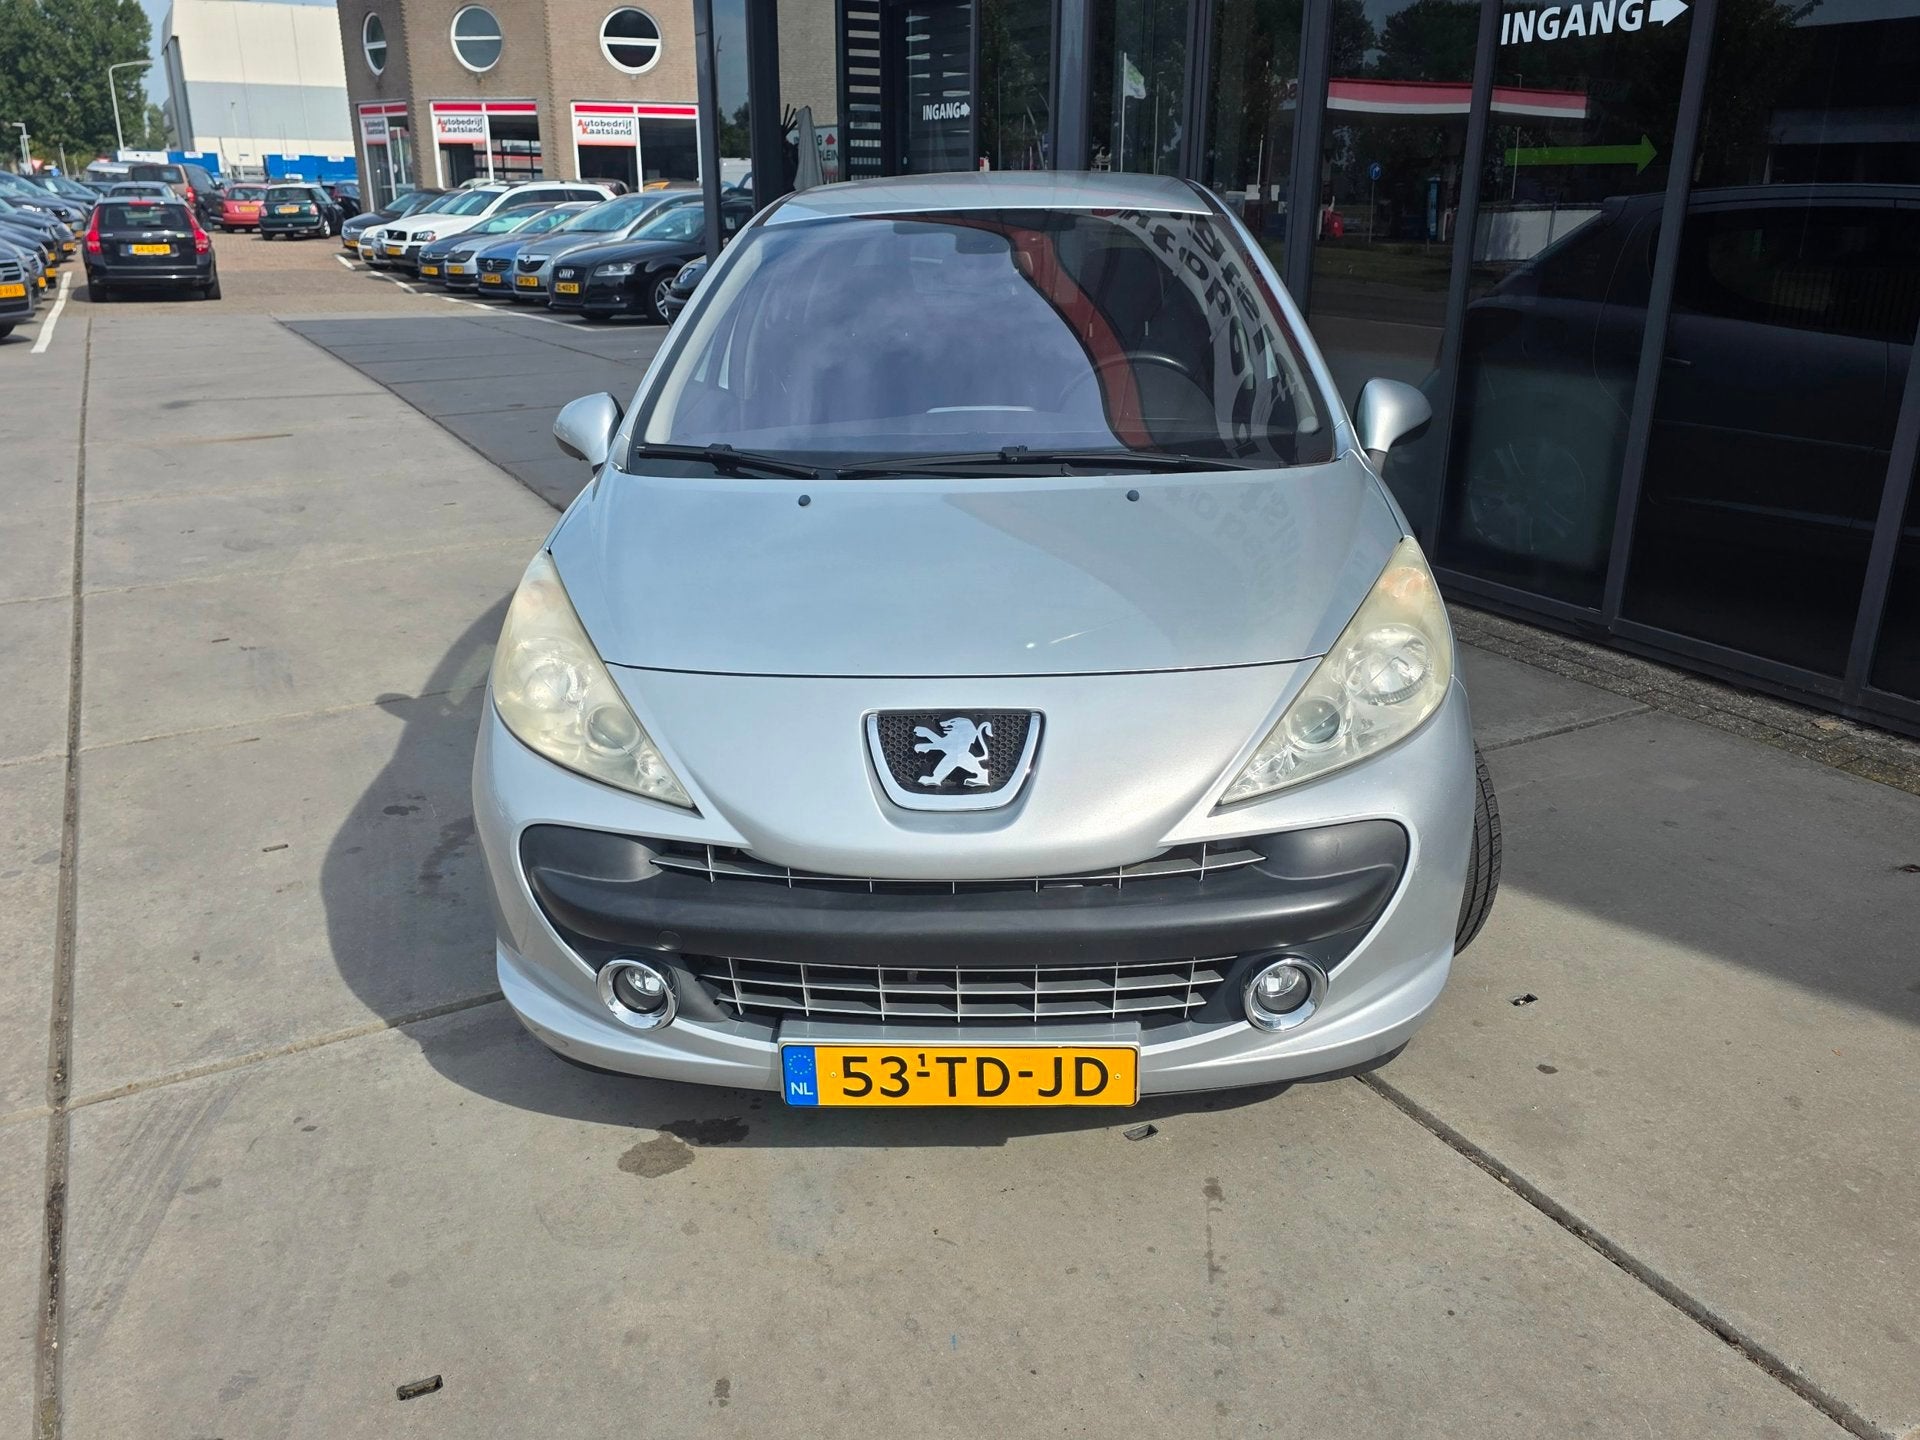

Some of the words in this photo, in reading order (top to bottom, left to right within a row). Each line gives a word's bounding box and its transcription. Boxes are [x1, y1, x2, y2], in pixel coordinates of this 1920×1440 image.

[1500, 0, 1644, 46] INGANG
[922, 101, 961, 121] INGANG
[437, 117, 483, 128] Autobedrijf
[577, 119, 632, 129] Autobedrijf
[582, 127, 632, 135] Kaatsland
[790, 1082, 814, 1096] NL
